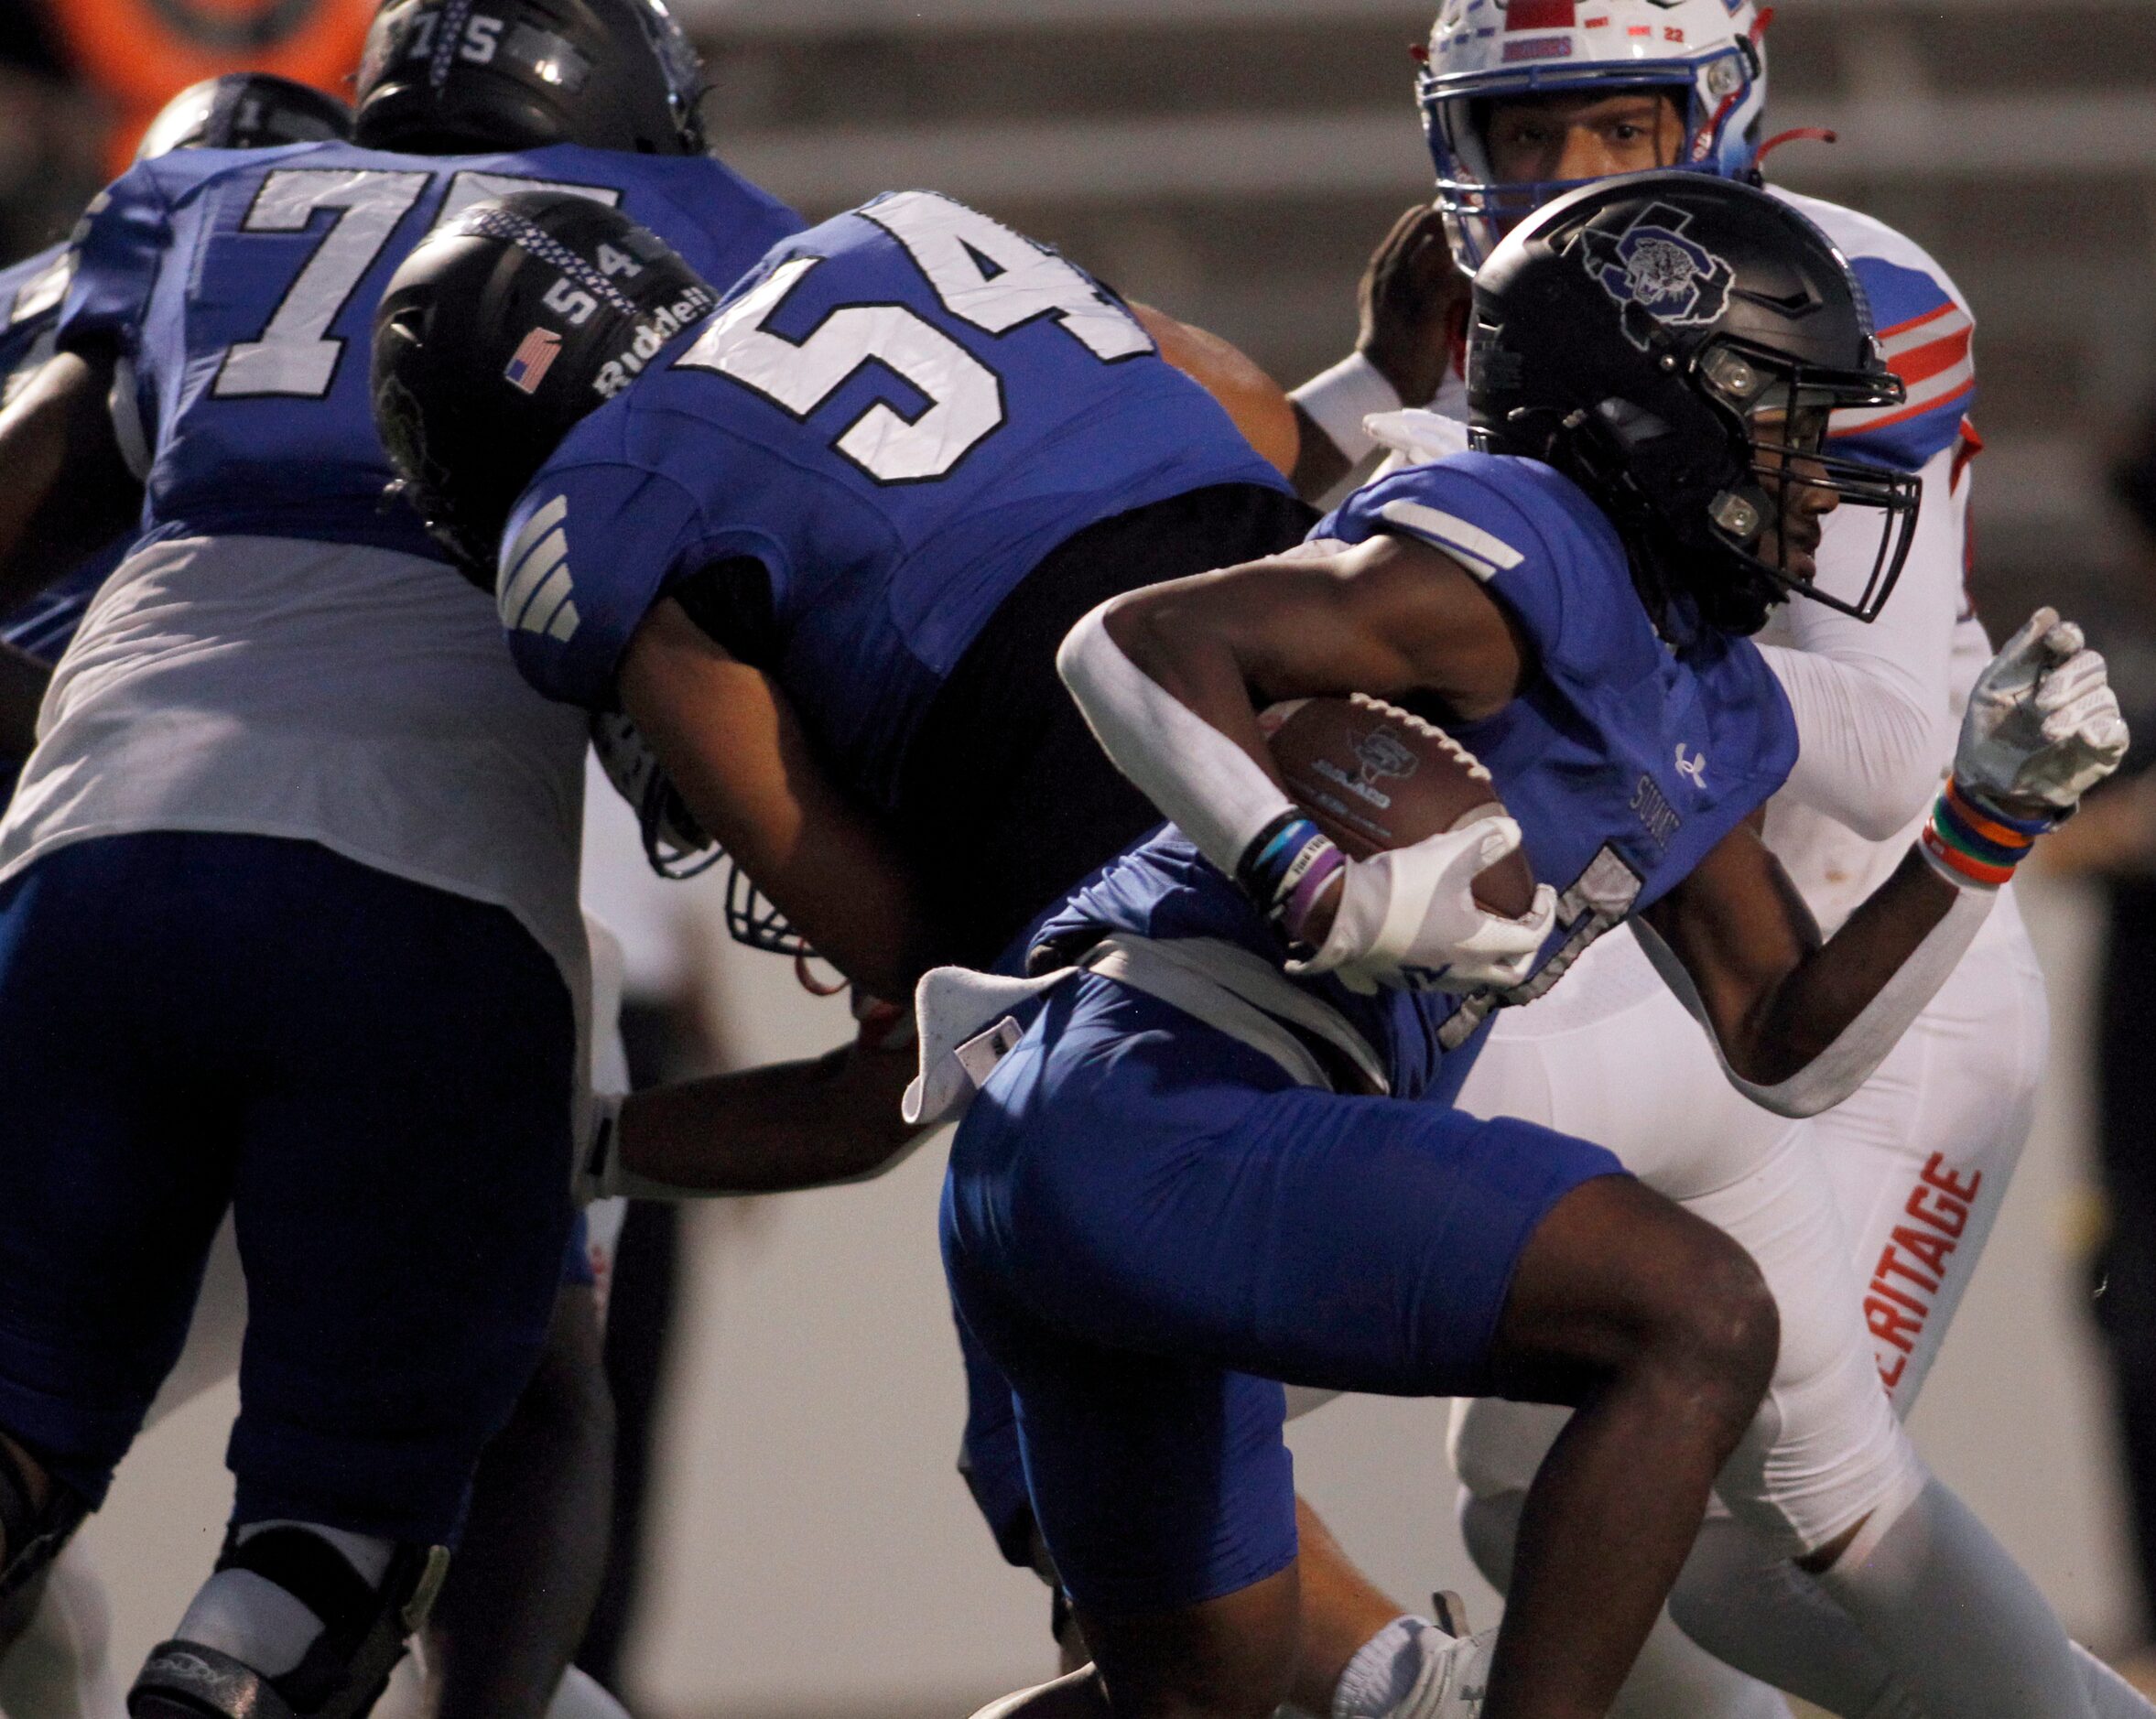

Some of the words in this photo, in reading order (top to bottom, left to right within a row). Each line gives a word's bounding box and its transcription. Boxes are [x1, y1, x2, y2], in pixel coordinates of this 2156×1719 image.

[409, 11, 504, 63] 75
[1663, 25, 1684, 44] 22
[543, 243, 643, 324] 54
[592, 286, 713, 398] Riddell
[666, 190, 1156, 486] 54
[1863, 1151, 1982, 1398] ERITAGE
